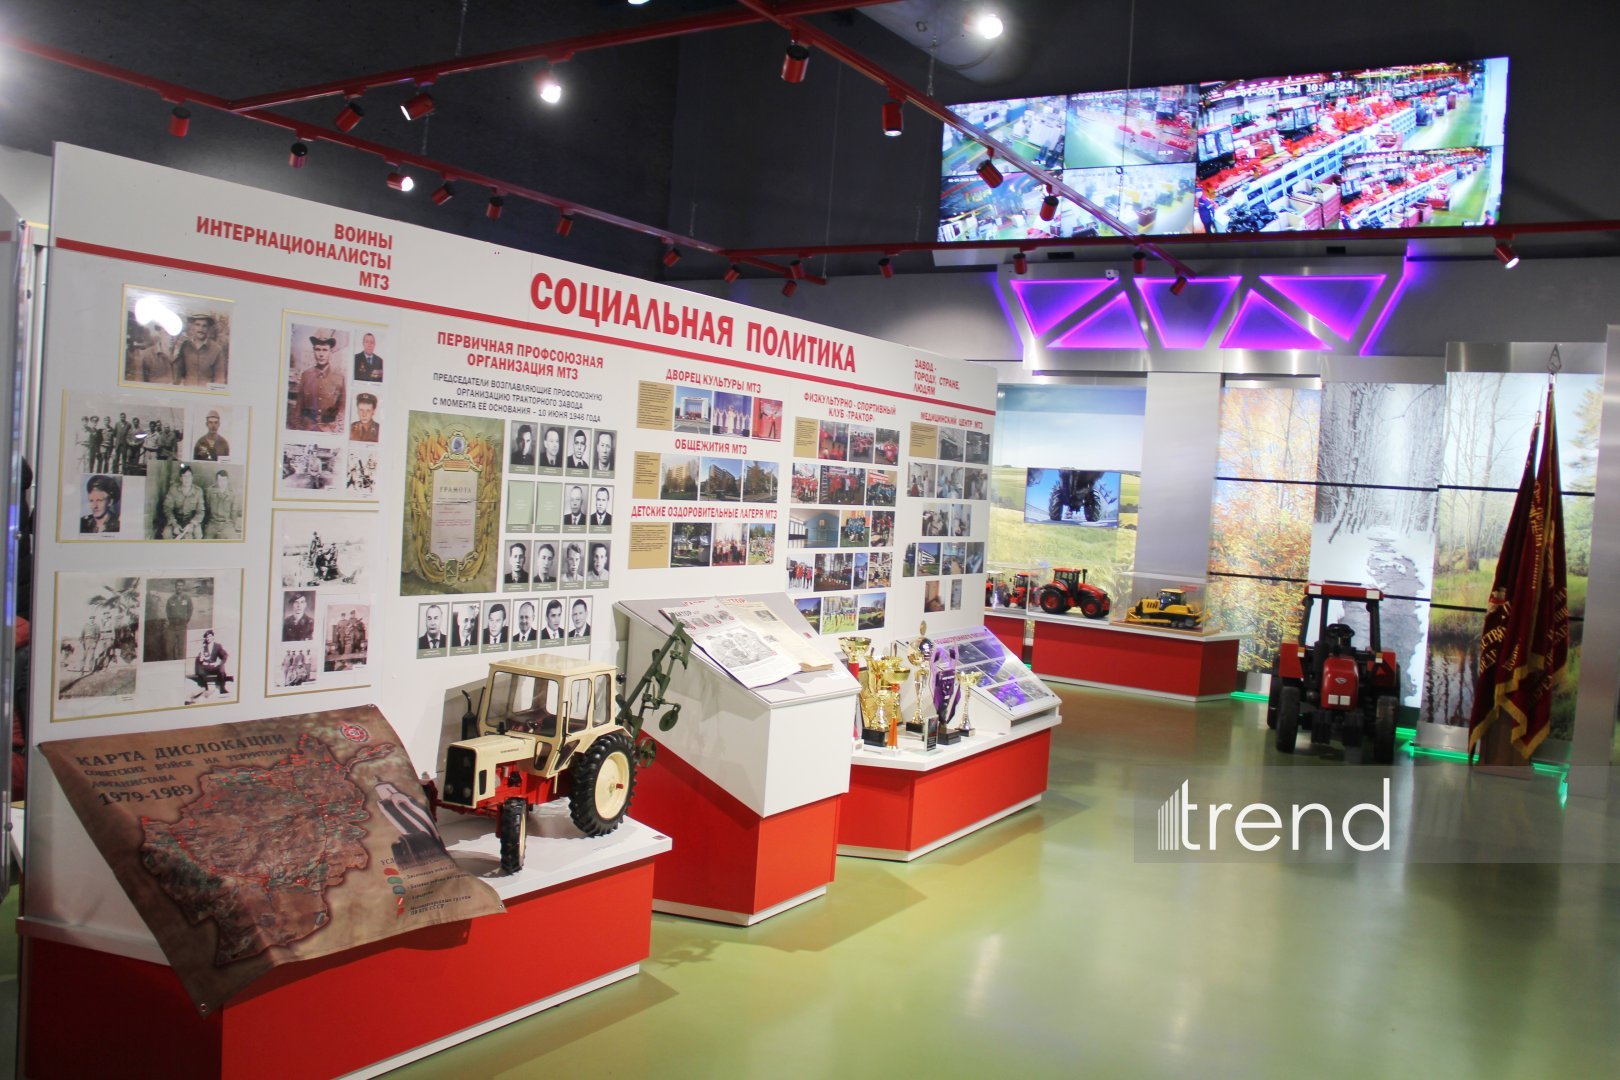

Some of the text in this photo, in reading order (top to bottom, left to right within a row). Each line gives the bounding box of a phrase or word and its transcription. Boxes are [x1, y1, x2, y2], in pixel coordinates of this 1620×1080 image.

[196, 215, 392, 270] ИНТЕРНАЦИОНАЛИСТЫ
[334, 223, 393, 250] ВОИНЫ
[359, 270, 390, 291] МТЗ
[530, 272, 856, 373] СОЦИАЛЬНАЯ ПОЛИТИКА
[437, 331, 604, 369] ПЕРВИЧНАЯ ПРОФСОЮЗНАЯ
[467, 353, 578, 380] ОРГАНИЗАЦИЯ МТЗ
[914, 359, 934, 372] ЗАВОД
[433, 372, 603, 402] ПРЕДСЕДАТЕЛИ ВОЗГЛАВЛЯЮЩИЕ ПРОФСОЮЗНУЮ
[666, 369, 761, 393] ДВОРЕЦ КУЛЬТУРЫ МТЗ
[432, 397, 439, 406] С
[439, 398, 476, 411] МОМЕНТА
[488, 403, 531, 416] ОСНОВАНИЯ
[538, 408, 547, 417] 10
[548, 410, 568, 420] ИЮНЯ
[569, 412, 585, 421] 1946
[586, 414, 601, 423] ГОДА
[456, 387, 583, 410] ОРГАНИЗАЦИЮ ТРАКТОРНОГО ЗАВОДА
[804, 392, 852, 409] ФИЗКУЛЬТУРНО
[857, 401, 896, 415] СПОРТИВНЫЙ
[828, 408, 844, 418] КЛУБ
[675, 438, 747, 455] ОБЩЕЖИТИЯ МТЗ
[631, 505, 777, 520] ДЕТСКИЕ ОЗДОРОВИТЕЛЬНЫЕ ЛАГЕРЯ МТЗ
[76, 734, 287, 767] КАРТА ДИСЛОКАЦИИ
[84, 747, 293, 777] СОВЕТСКИХ ВОЙСК НА ТЕРРИТОРИИ
[99, 784, 195, 806] 1979-1989
